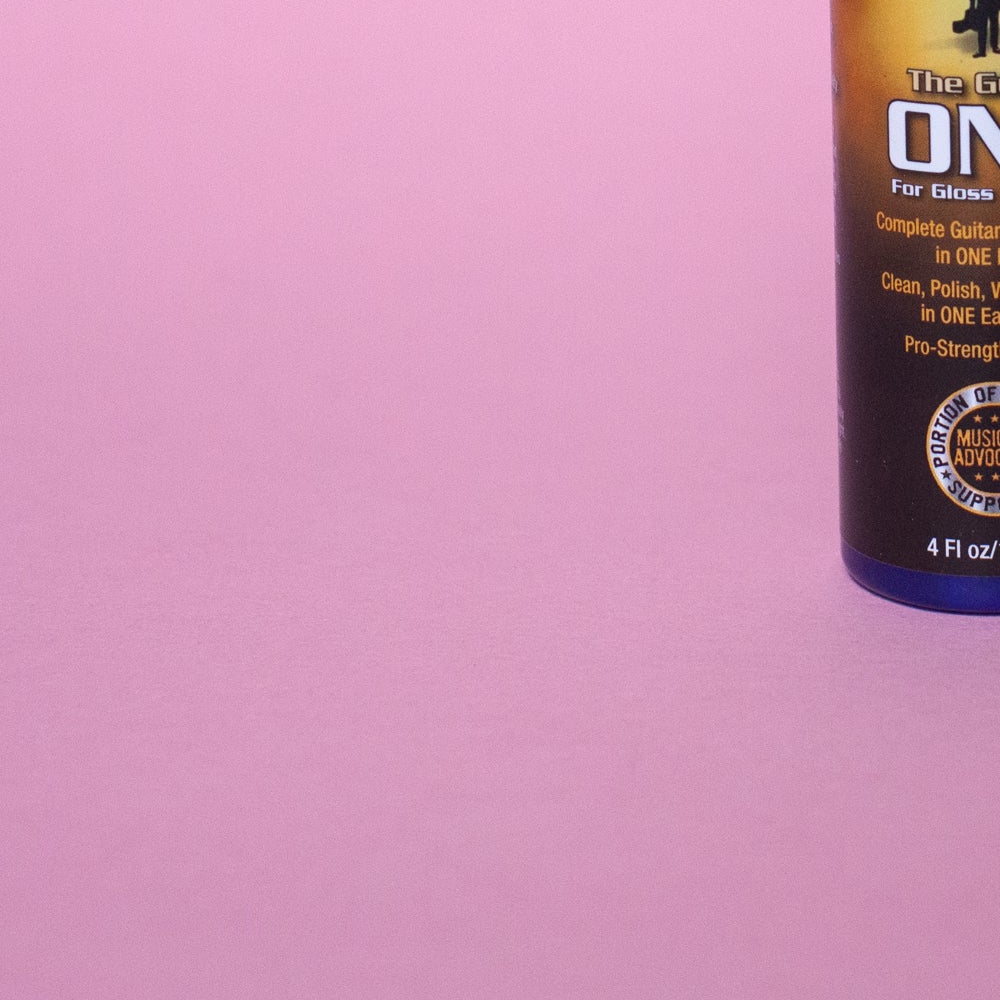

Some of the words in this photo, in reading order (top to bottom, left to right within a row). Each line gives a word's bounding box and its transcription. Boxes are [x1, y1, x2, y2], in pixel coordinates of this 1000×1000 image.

[906, 68, 964, 94] The
[892, 178, 923, 197] For
[931, 183, 994, 201] Gloss
[876, 211, 945, 238] Complete
[950, 220, 1000, 239] Guitar
[936, 246, 950, 264] in
[956, 248, 992, 266] ONE
[882, 271, 926, 298] Clean,
[930, 279, 986, 301] Polish,
[921, 304, 935, 323] in
[940, 307, 975, 325] ONE
[930, 394, 970, 469] PORTION
[974, 385, 998, 404] OF
[927, 538, 939, 557] 4
